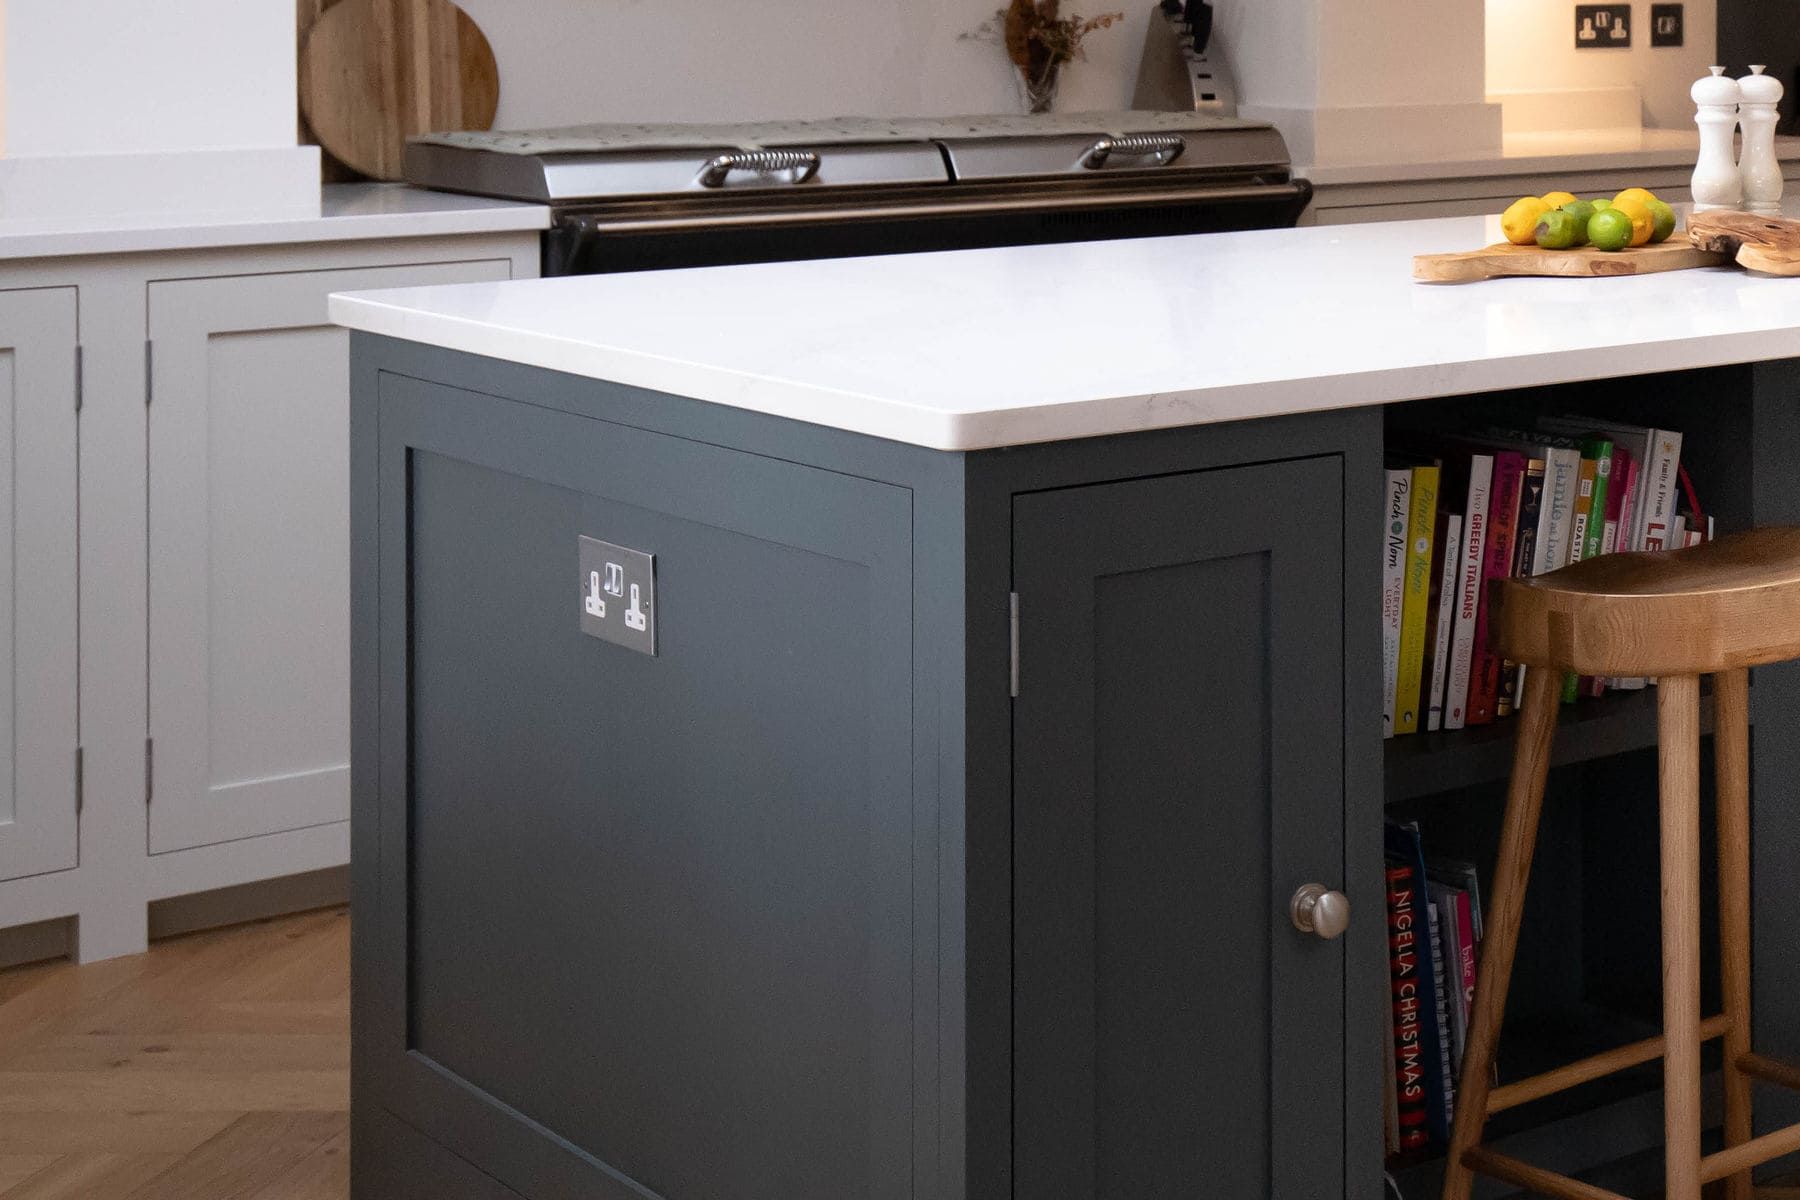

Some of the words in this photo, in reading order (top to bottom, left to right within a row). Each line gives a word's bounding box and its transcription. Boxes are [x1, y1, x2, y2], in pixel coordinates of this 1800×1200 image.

[1658, 458, 1670, 482] Family
[1392, 478, 1409, 520] Pinch
[1474, 487, 1485, 510] Two
[1550, 460, 1573, 521] jamie
[1655, 490, 1666, 518] Friends
[1389, 535, 1404, 570] Nom
[1447, 545, 1456, 566] Taste
[1468, 513, 1482, 561] GREEDY
[1494, 532, 1507, 572] SPICE
[1571, 517, 1586, 562] ROASTI
[1645, 522, 1666, 552] LE
[1445, 567, 1453, 578] of
[1463, 565, 1478, 620] ITALIANS
[1384, 588, 1392, 618] LIGHT
[1392, 577, 1401, 629] EVERYDAY
[1395, 890, 1415, 977] NIGELLA
[1400, 983, 1421, 1098] CHRISTMAS
